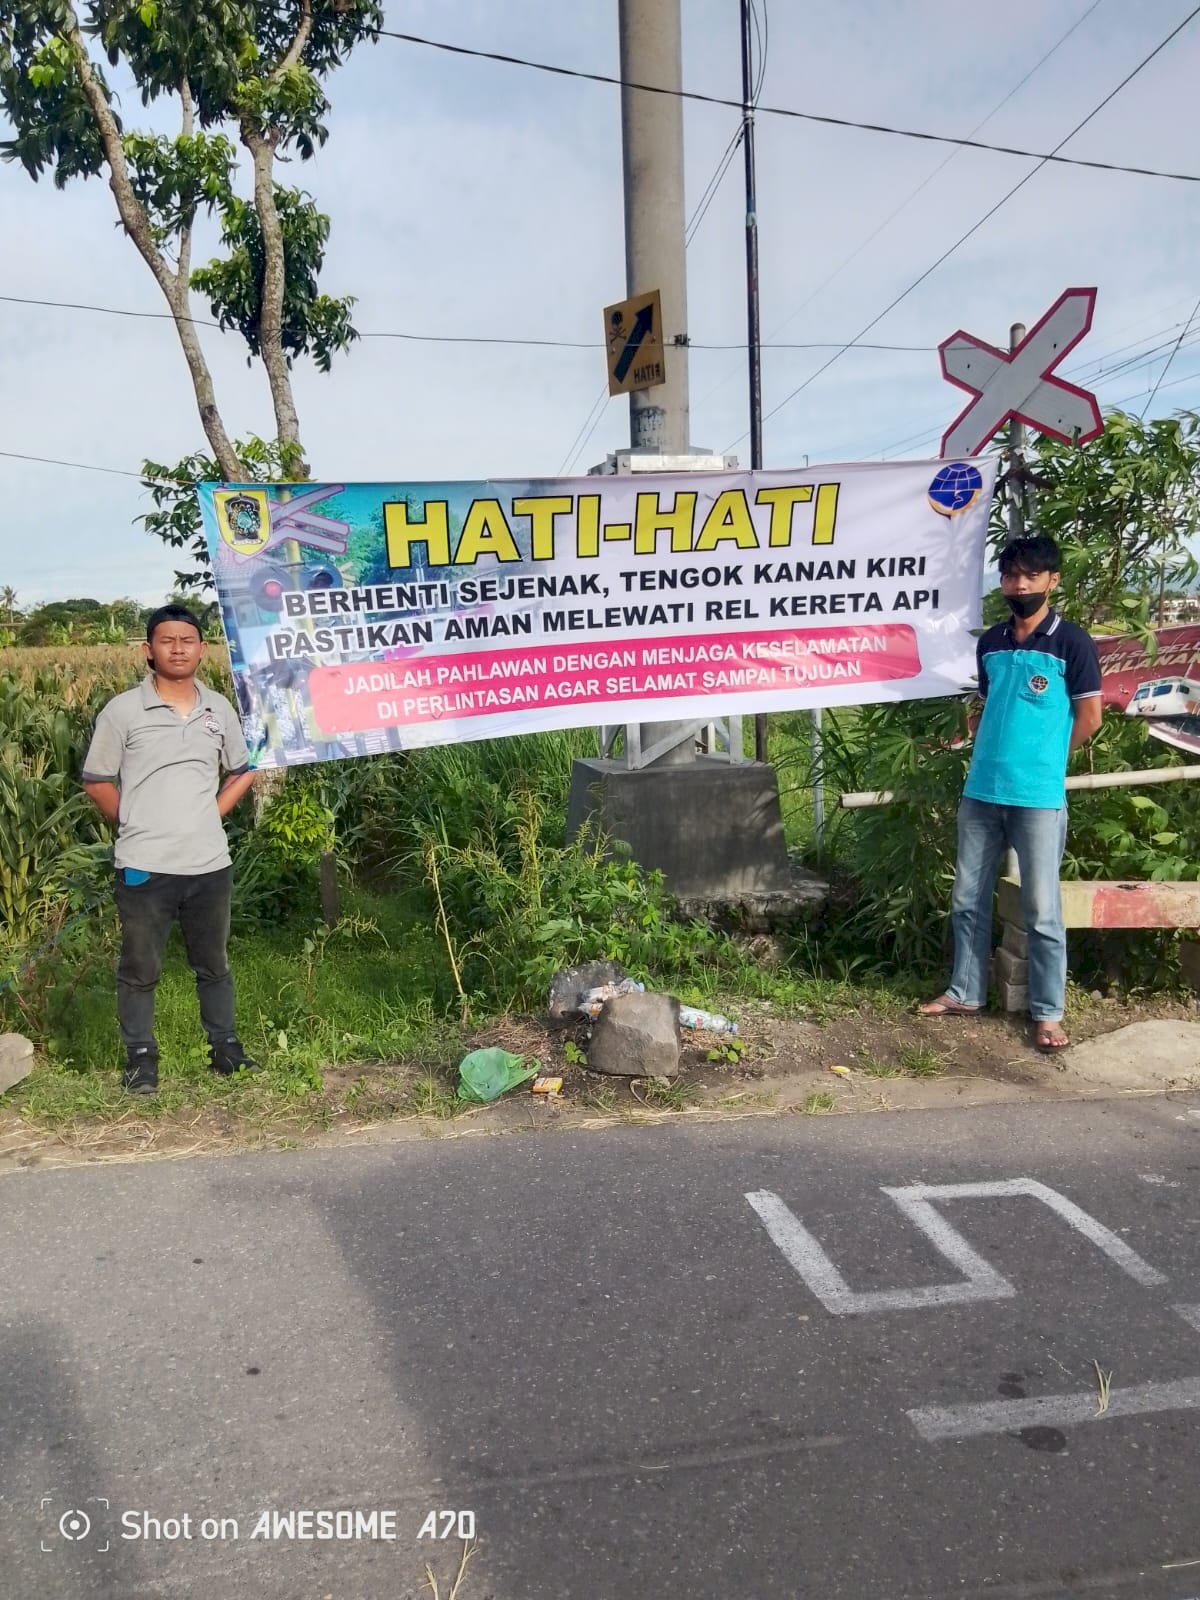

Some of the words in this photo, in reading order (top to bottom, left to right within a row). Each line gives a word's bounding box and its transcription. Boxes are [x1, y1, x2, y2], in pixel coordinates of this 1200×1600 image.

[383, 482, 840, 569] HATI-HATI
[284, 583, 448, 617] BERHENTI
[459, 573, 609, 606] SEJENAK,
[620, 564, 743, 592] TENGOK
[754, 558, 856, 584] KANAN
[866, 556, 926, 578] KIRI
[273, 620, 433, 657] PASTIKAN
[444, 613, 532, 641] AMAN
[543, 602, 694, 633] MELEWATI
[705, 598, 759, 621] REL
[769, 591, 883, 617] KERETA
[892, 589, 939, 611] API
[343, 668, 431, 695] JADILAH
[437, 659, 547, 685] PAHLAWAN
[553, 649, 636, 674] DENGAN
[642, 643, 737, 666] MENJAGA
[742, 635, 887, 660] KESELAMATAN
[378, 702, 398, 719] DI
[403, 691, 539, 718] PERLINTASAN
[543, 678, 600, 698] AGAR
[605, 672, 697, 695] SELAMAT
[703, 666, 776, 688] SAMPAI
[781, 661, 861, 683] TUJUAN
